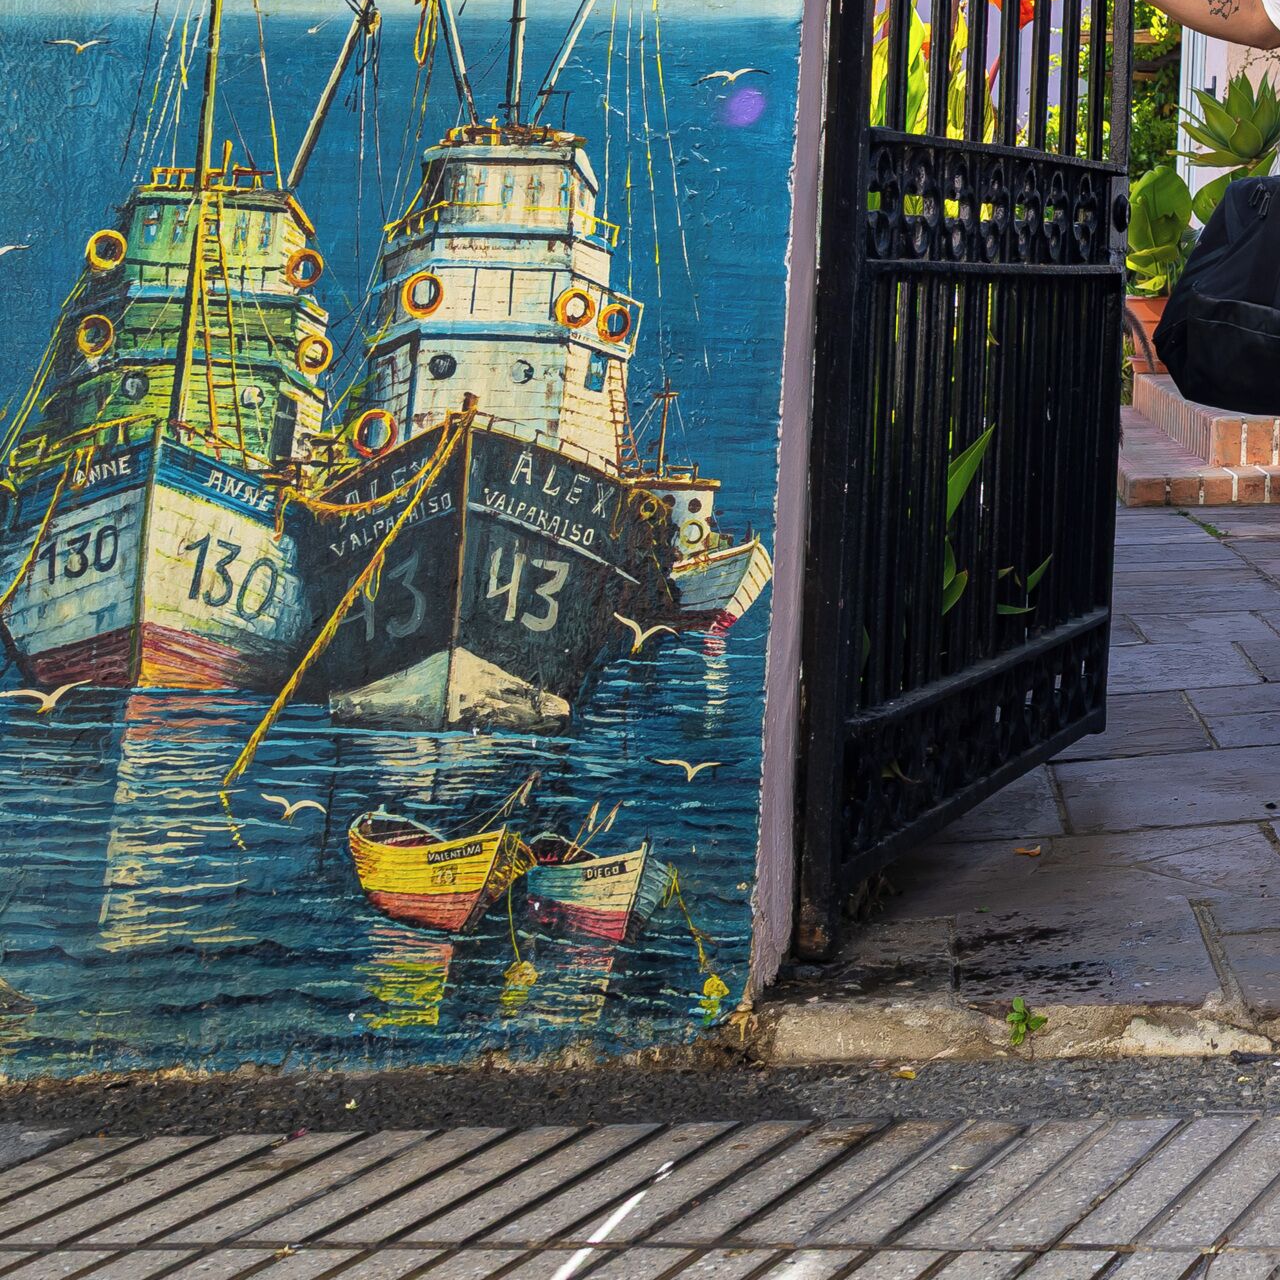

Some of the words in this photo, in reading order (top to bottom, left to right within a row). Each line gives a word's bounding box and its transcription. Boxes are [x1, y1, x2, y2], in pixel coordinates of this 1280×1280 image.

[72, 454, 132, 489] ANNE
[202, 468, 275, 512] ANNE
[510, 450, 615, 519] ALEX
[483, 487, 596, 547] VALPARAISO
[38, 524, 119, 585] 130
[184, 532, 279, 621] 130
[486, 539, 570, 632] 43
[428, 844, 481, 862] VALENTINA
[586, 865, 620, 881] DIEGO
